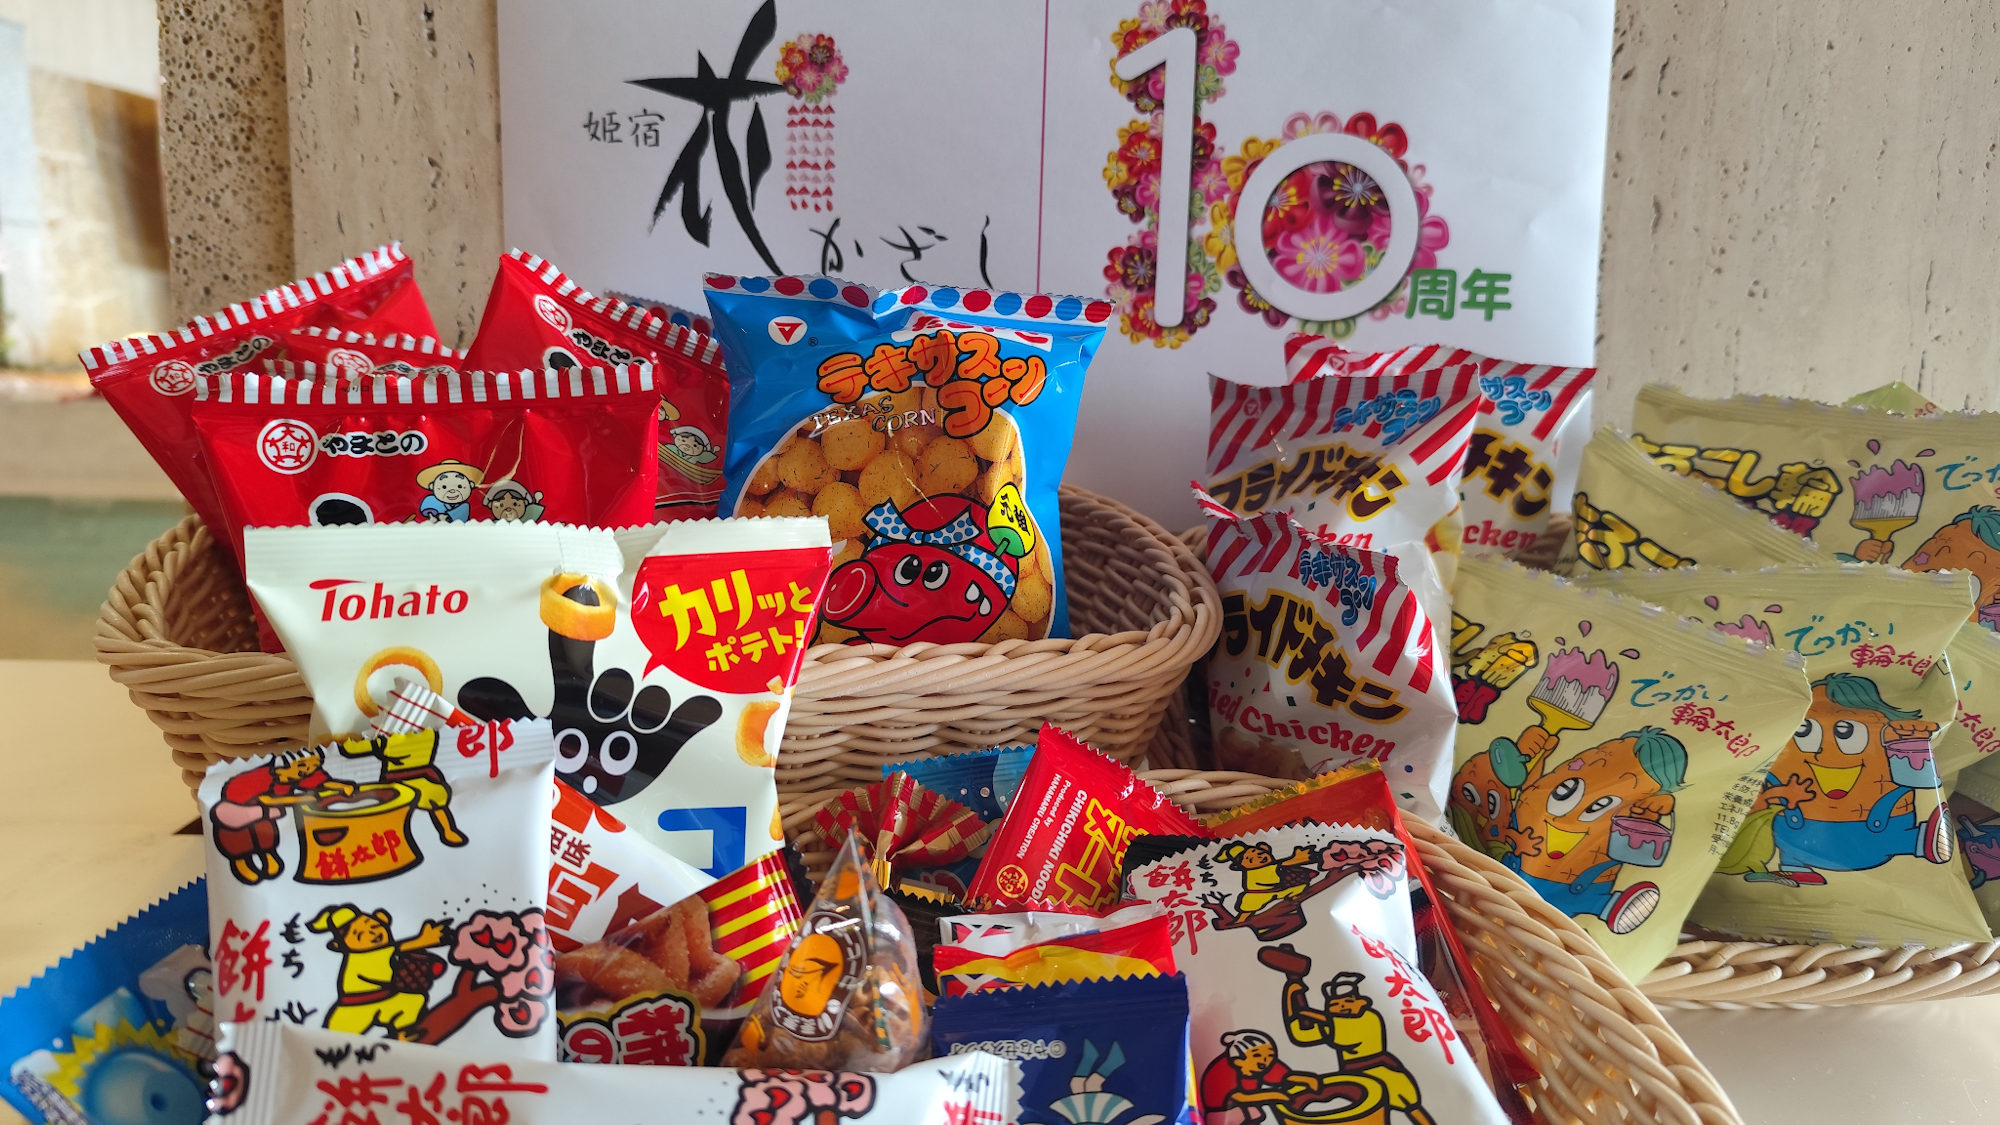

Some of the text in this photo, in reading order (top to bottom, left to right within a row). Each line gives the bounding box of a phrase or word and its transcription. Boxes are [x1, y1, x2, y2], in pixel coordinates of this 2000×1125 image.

[583, 109, 665, 148] 姫宿
[1405, 268, 1512, 322] 周年
[572, 330, 648, 367] やまと
[817, 330, 1001, 404] テキサス
[810, 395, 895, 430] TEXAS
[872, 407, 936, 433] CORN
[321, 432, 427, 455] やまとの
[1462, 520, 1537, 548] cken
[309, 579, 469, 622] Tohato
[659, 568, 815, 651] カリッと
[1221, 588, 1411, 724] ライドチキン
[1239, 705, 1396, 763] Chicken
[1954, 700, 2000, 753] 太郎
[1016, 773, 1063, 860] HANAMARU CREATION
[1049, 778, 1072, 818] Produced
[1028, 789, 1088, 902] CHIKICHIKI NOOD
